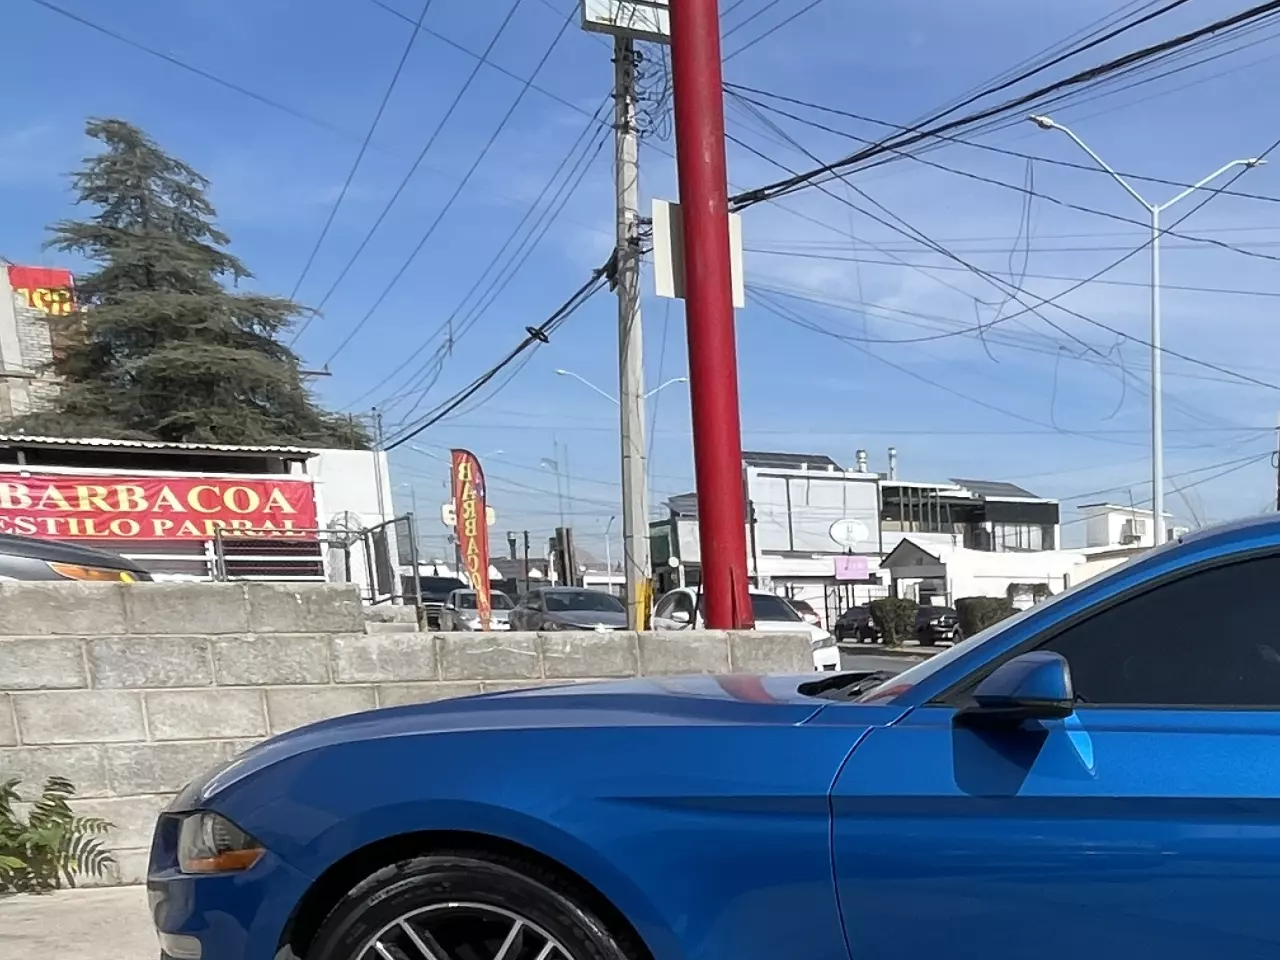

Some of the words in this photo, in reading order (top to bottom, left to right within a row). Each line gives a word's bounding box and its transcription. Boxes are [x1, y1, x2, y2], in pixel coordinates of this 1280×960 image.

[0, 482, 297, 515] BARBACOA
[0, 516, 141, 536] ESTILO
[151, 518, 307, 537] PARRAL
